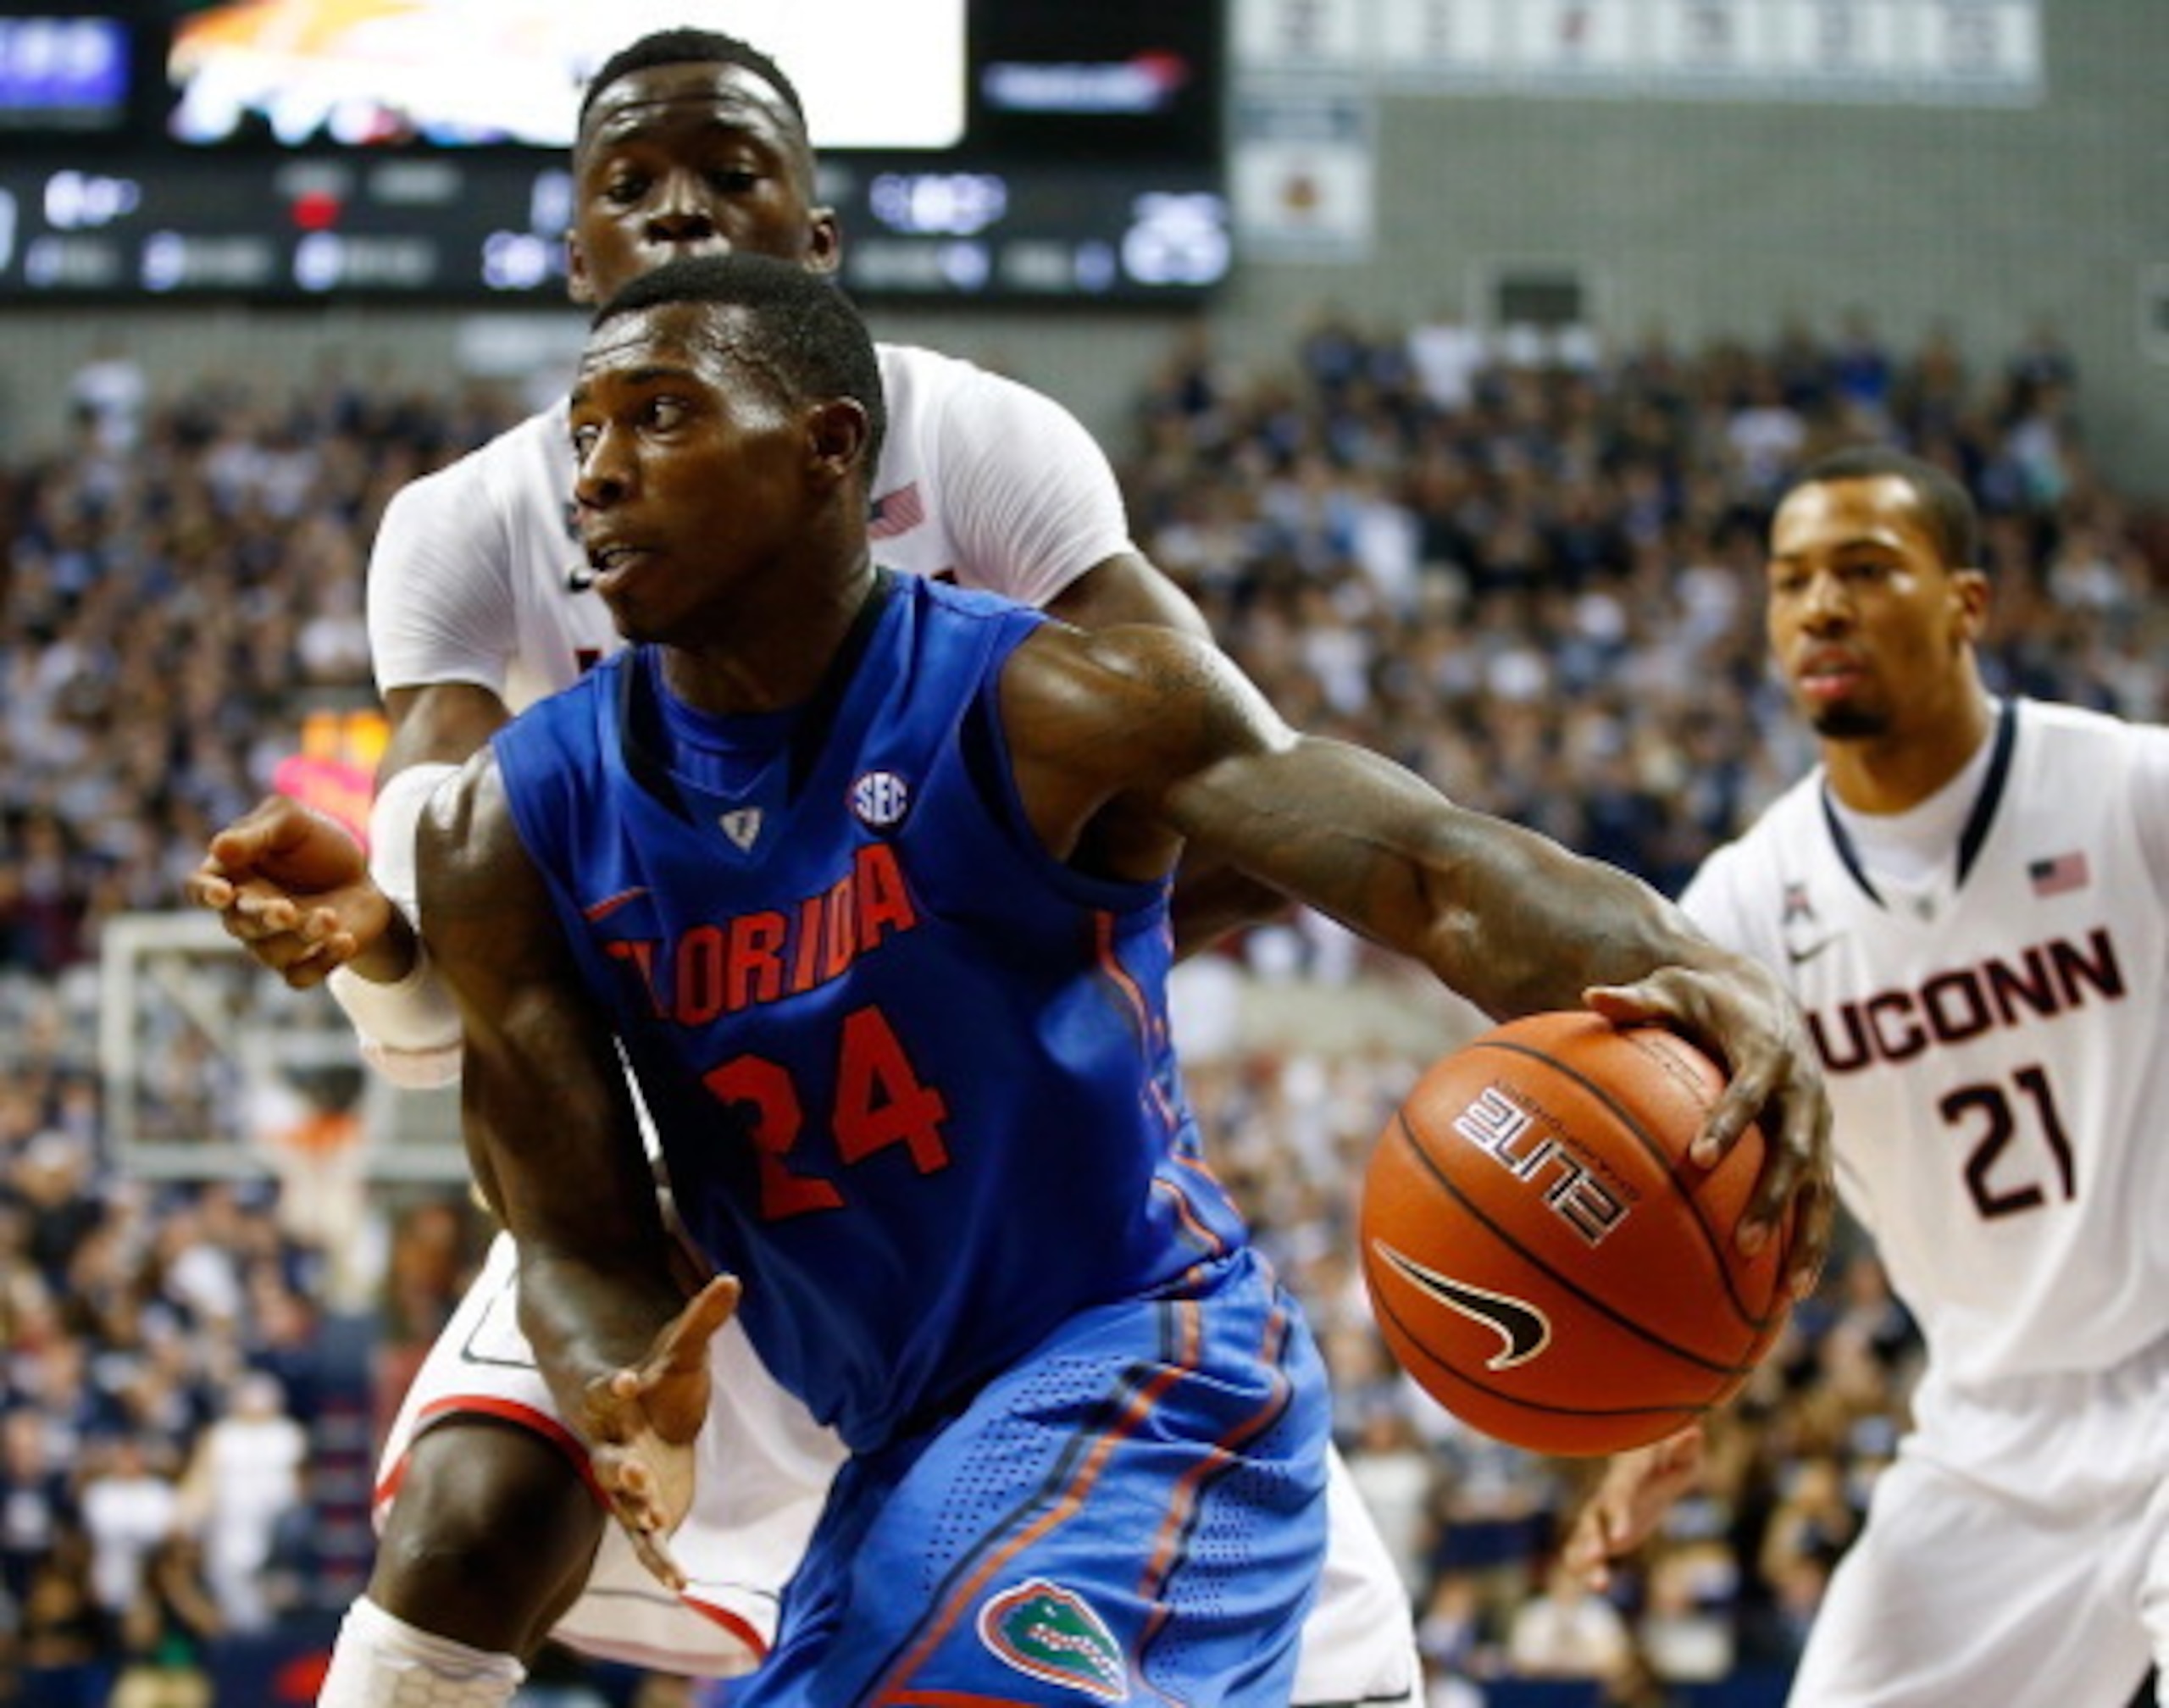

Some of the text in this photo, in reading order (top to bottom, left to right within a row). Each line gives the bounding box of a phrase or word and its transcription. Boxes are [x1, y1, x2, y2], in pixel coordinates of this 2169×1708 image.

[853, 771, 908, 826] SEC
[606, 843, 914, 1027] LORIDA
[1805, 926, 2127, 1074] UCONN
[702, 1003, 951, 1222] 24
[1450, 1084, 1632, 1248] ELITE
[1939, 1059, 2077, 1222] 21
